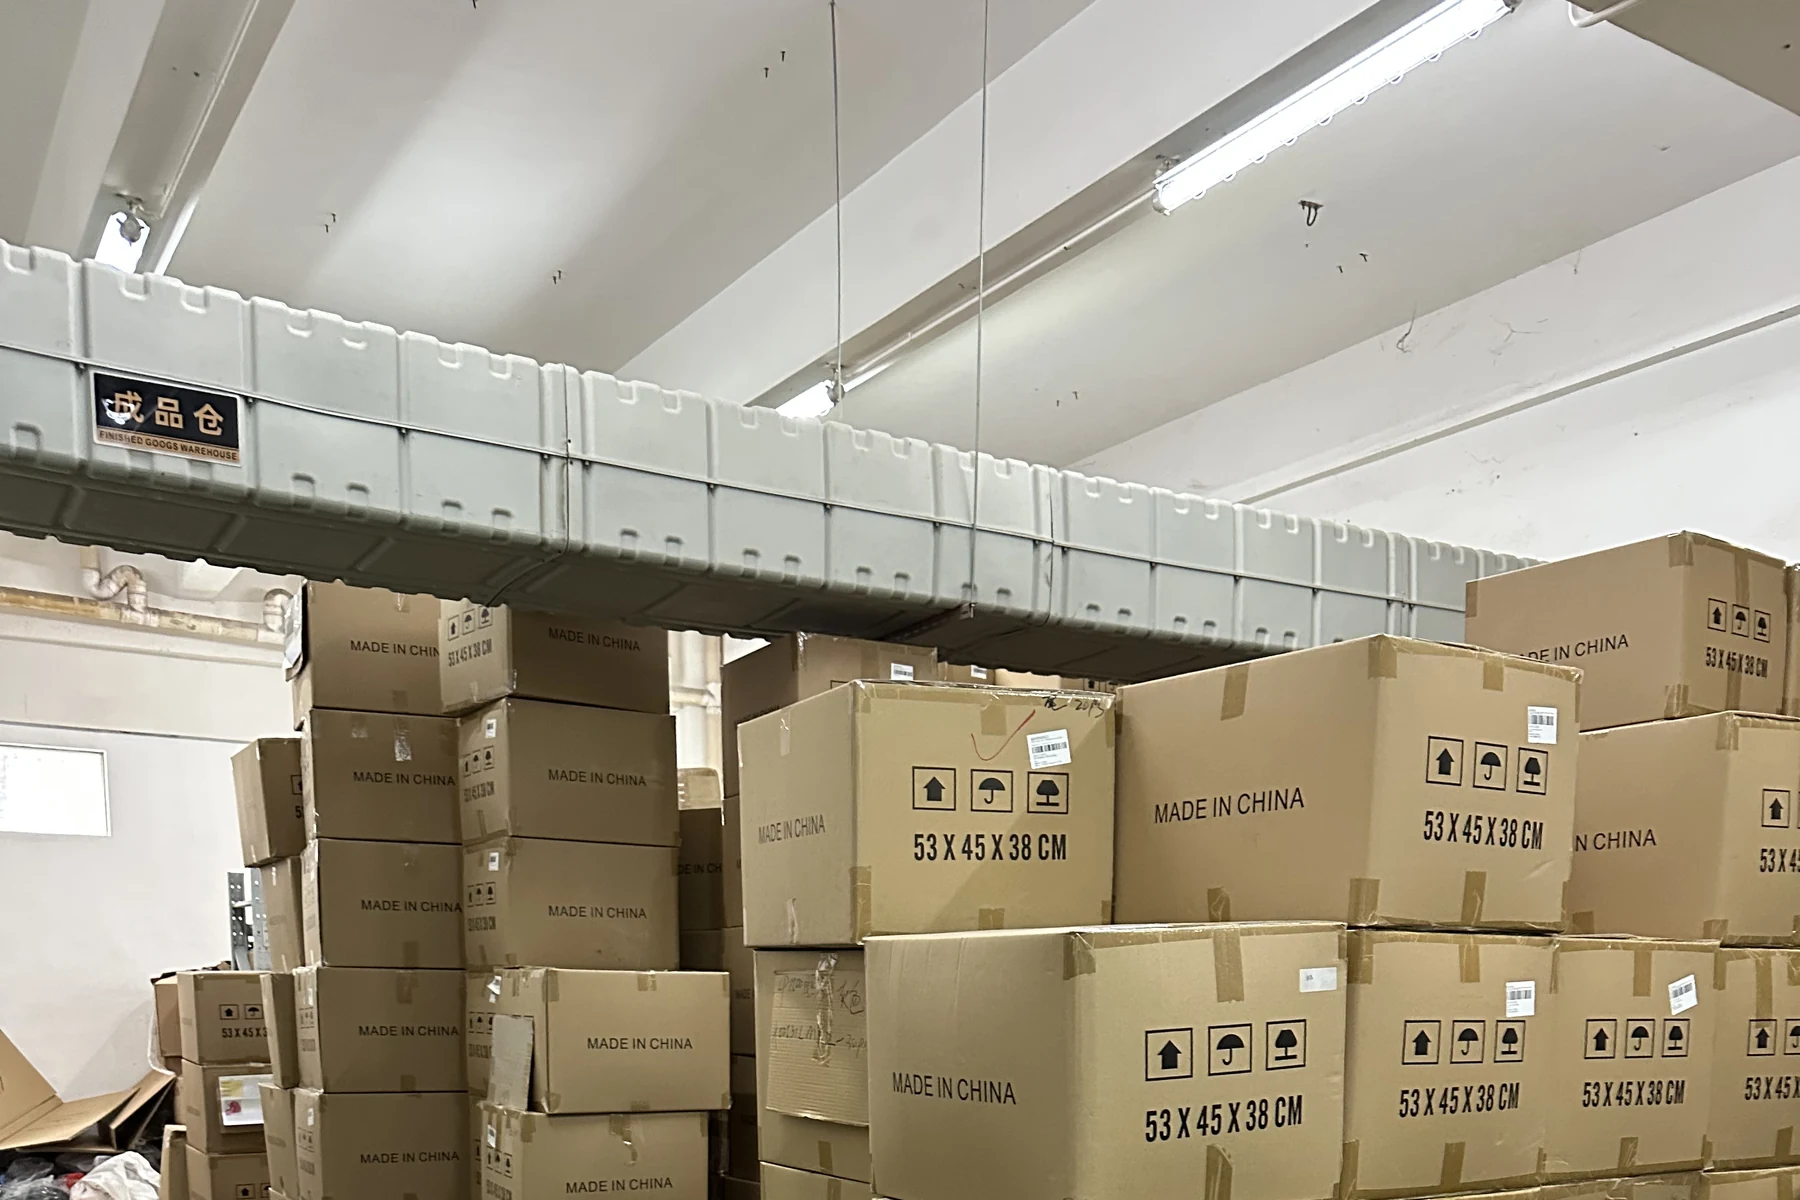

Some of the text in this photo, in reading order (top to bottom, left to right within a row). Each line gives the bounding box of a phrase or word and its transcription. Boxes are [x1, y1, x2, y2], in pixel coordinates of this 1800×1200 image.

[114, 390, 224, 436] 成品仓
[100, 431, 237, 460] FINISHED GOOGS WAREHOUSE
[350, 640, 406, 654] MADE IN
[548, 626, 640, 651] MADE IN CHINA
[1555, 634, 1628, 660] IN CHINA
[353, 771, 455, 785] MADE IN CHINA
[548, 768, 646, 786] MADE IN CHINA
[1155, 787, 1304, 823] MADE IN CHINA
[759, 814, 825, 844] MADE IN CHINA
[1423, 810, 1543, 850] 53 X 45 X 38 CM
[1594, 829, 1656, 850] CHINA
[914, 833, 1066, 861] 53 X 45 X 38 CM
[361, 899, 463, 913] MADE IN CHINA
[548, 905, 646, 918] MADE IN CHINA
[358, 1025, 458, 1036] MADE IN CHINA
[587, 1037, 692, 1049] MADE IN CHINA
[893, 1072, 1016, 1105] MADE IN CHINA
[1399, 1082, 1519, 1118] 53 X 45 X 38 CM
[1582, 1079, 1685, 1107] 53 X 45 X 38 CM
[1145, 1094, 1302, 1142] 53 X 45 X 38 CM
[360, 1151, 459, 1163] MADE IN CHINA
[566, 1177, 672, 1193] MADE IN CHINA
